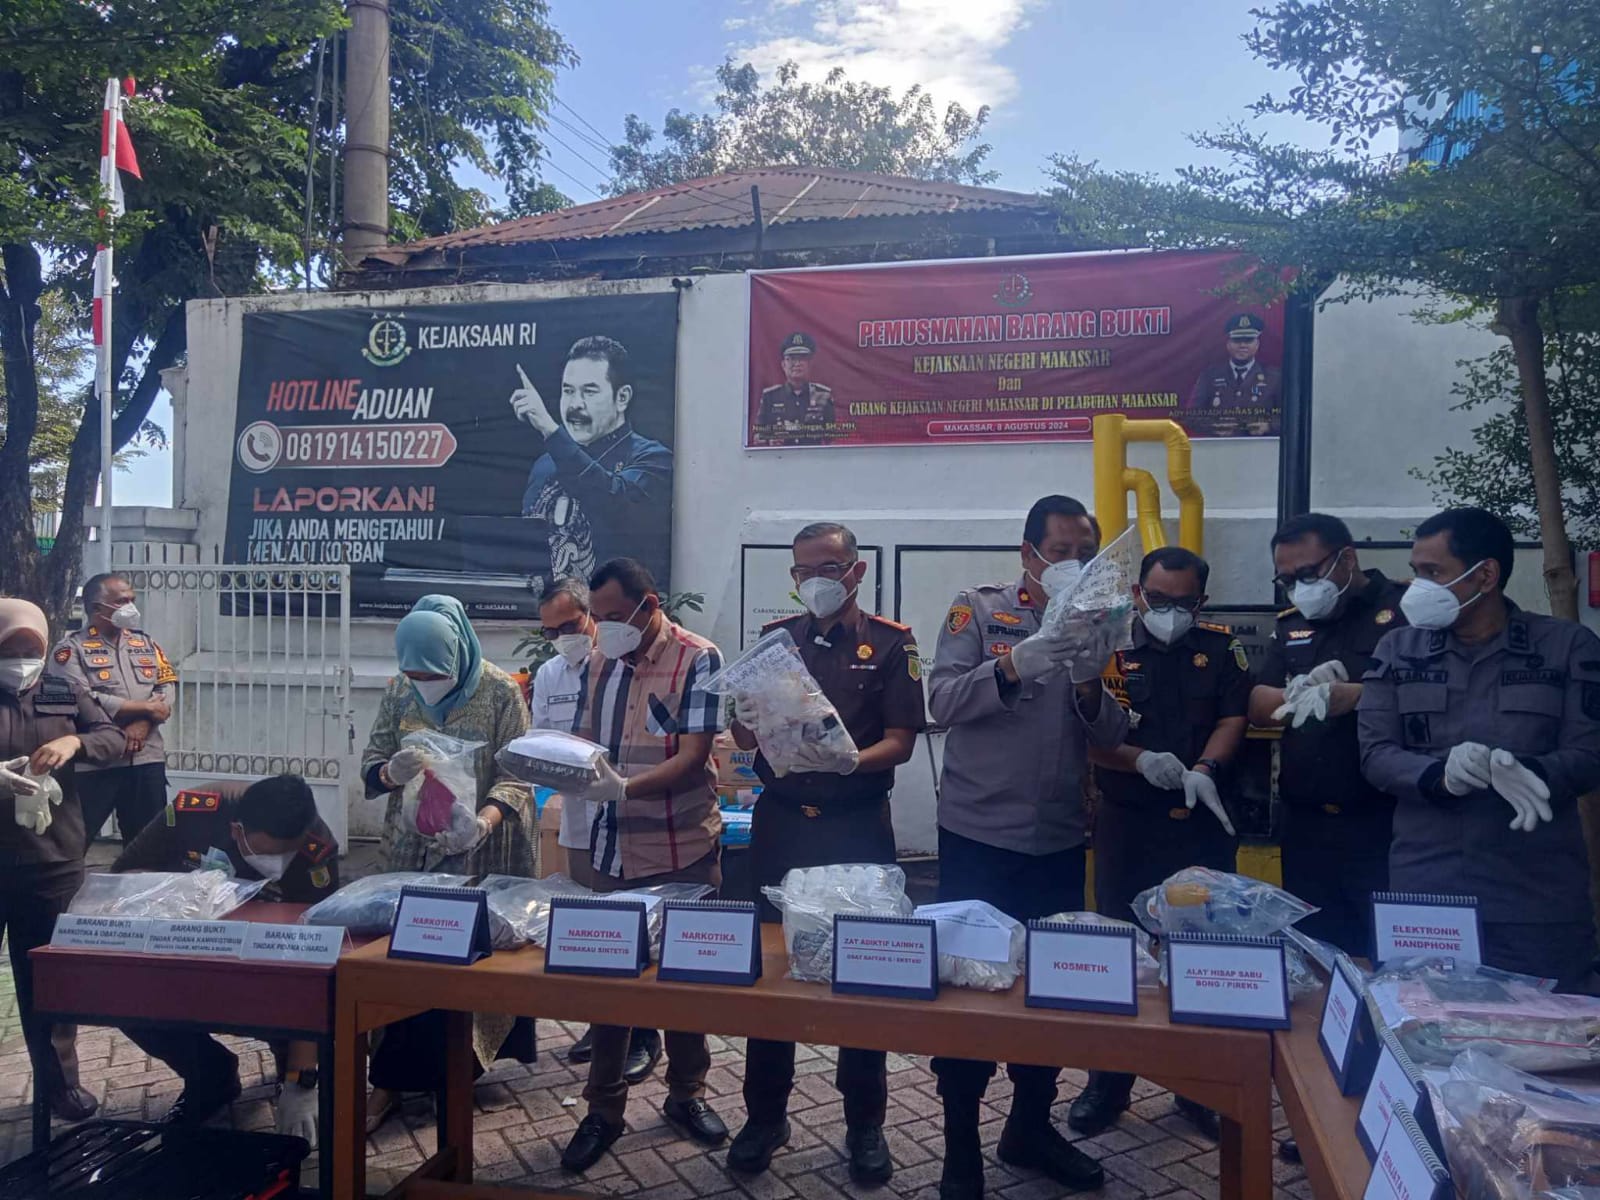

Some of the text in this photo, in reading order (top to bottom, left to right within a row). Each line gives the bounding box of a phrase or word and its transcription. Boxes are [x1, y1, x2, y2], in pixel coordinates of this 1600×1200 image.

[858, 306, 1171, 348] PEMUSNAHAN BARANG BUKTI
[418, 322, 537, 350] KEJAKSAAN RI
[912, 349, 1111, 375] KEJAKSAAN NEGERI MAKASSAR
[998, 376, 1022, 391] Dan
[266, 378, 434, 420] HOTLINE ADUAN
[850, 392, 1179, 416] CABANG KEJAKSAAN NEGERI MAKASSAR DI PELABUHAN MAKASSAR
[1004, 422, 1047, 432] AGUSTUS
[1049, 421, 1069, 430] 2024
[286, 430, 444, 461] 081914150227
[253, 486, 436, 512] LAPORKAN!
[248, 517, 446, 541] JIKA ANDA MENGETAHUI /
[412, 917, 460, 928] NARKOTIKA
[170, 925, 226, 934] BARANG BUKTI
[568, 929, 622, 940] NARKOTIKA
[1392, 925, 1461, 937] ELEKTRONIK
[265, 931, 323, 942] BARANG BUKTI
[681, 931, 736, 943] NARKOTIKA
[558, 945, 630, 955] TEMBAKAU SINTETIS
[1394, 940, 1462, 951] HANDPHONE
[697, 949, 718, 957] SABU
[1053, 961, 1110, 974] KOSMETIK
[1186, 968, 1208, 976] ALAT
[1238, 971, 1263, 979] SABU
[1195, 980, 1220, 988] BONG
[1227, 981, 1259, 990] PIREKS
